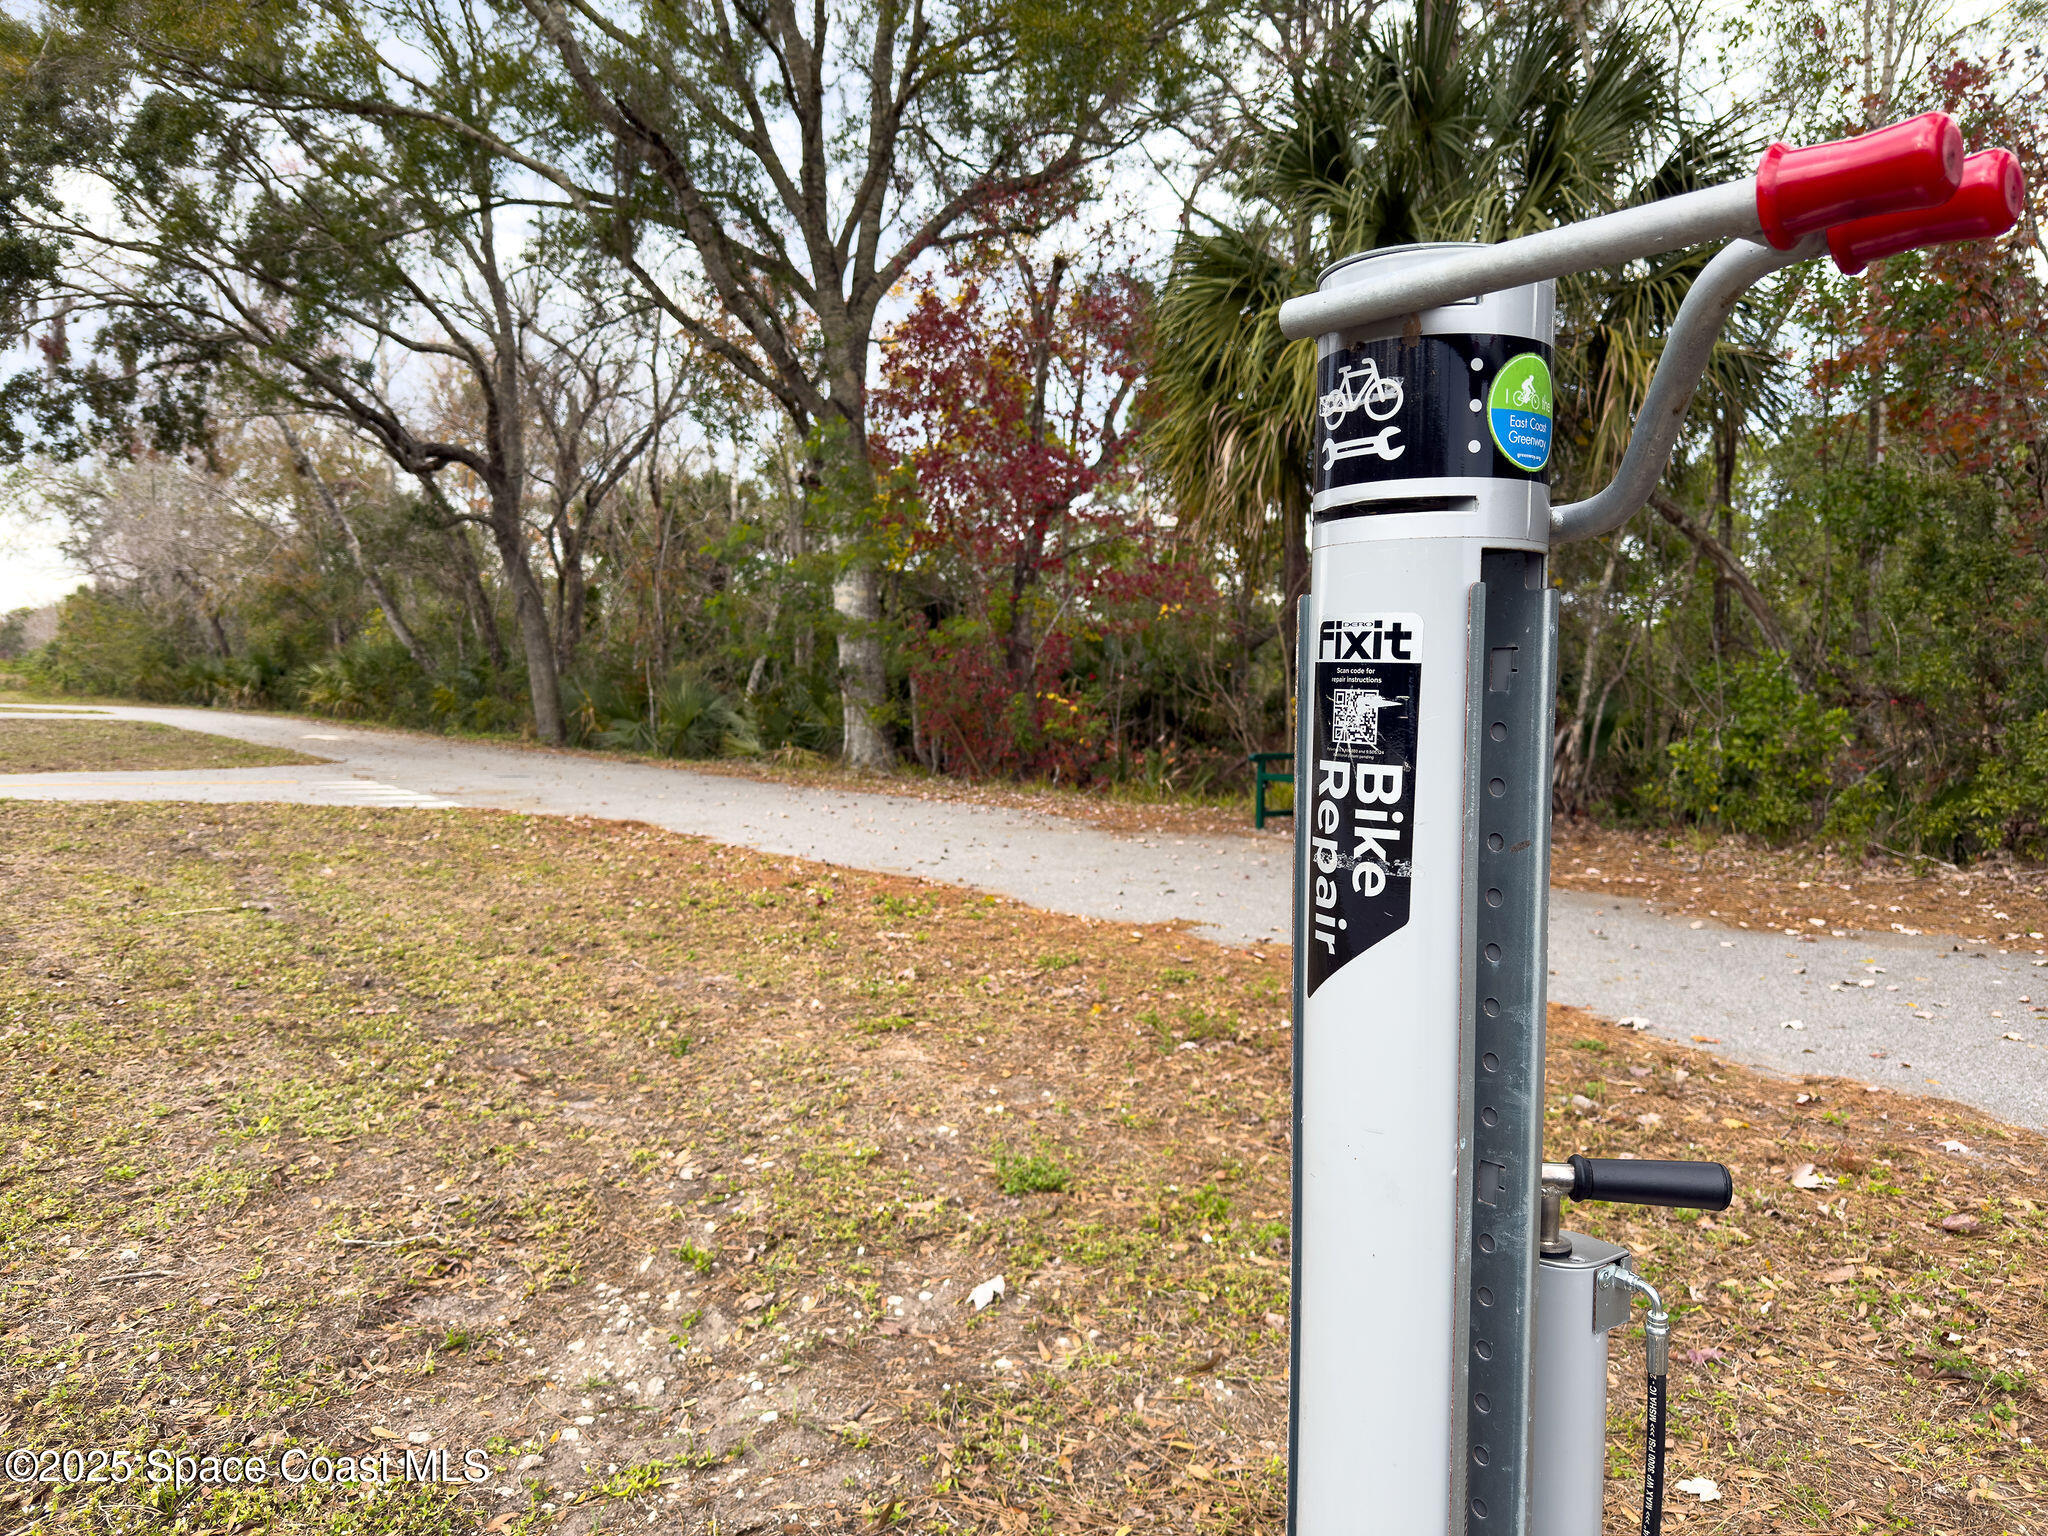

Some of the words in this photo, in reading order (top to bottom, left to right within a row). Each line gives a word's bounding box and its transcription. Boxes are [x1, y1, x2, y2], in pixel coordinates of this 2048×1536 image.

[1510, 415, 1527, 428] East
[1530, 418, 1546, 432] Coast
[1509, 430, 1546, 452] Greenway
[1319, 620, 1412, 660] fixit
[1352, 763, 1403, 897] Bike
[1312, 760, 1350, 955] Repair
[1649, 1397, 1657, 1423] MSHA
[1647, 1454, 1656, 1474] 3000
[1646, 1474, 1654, 1489] WP
[1645, 1489, 1653, 1510] MAX
